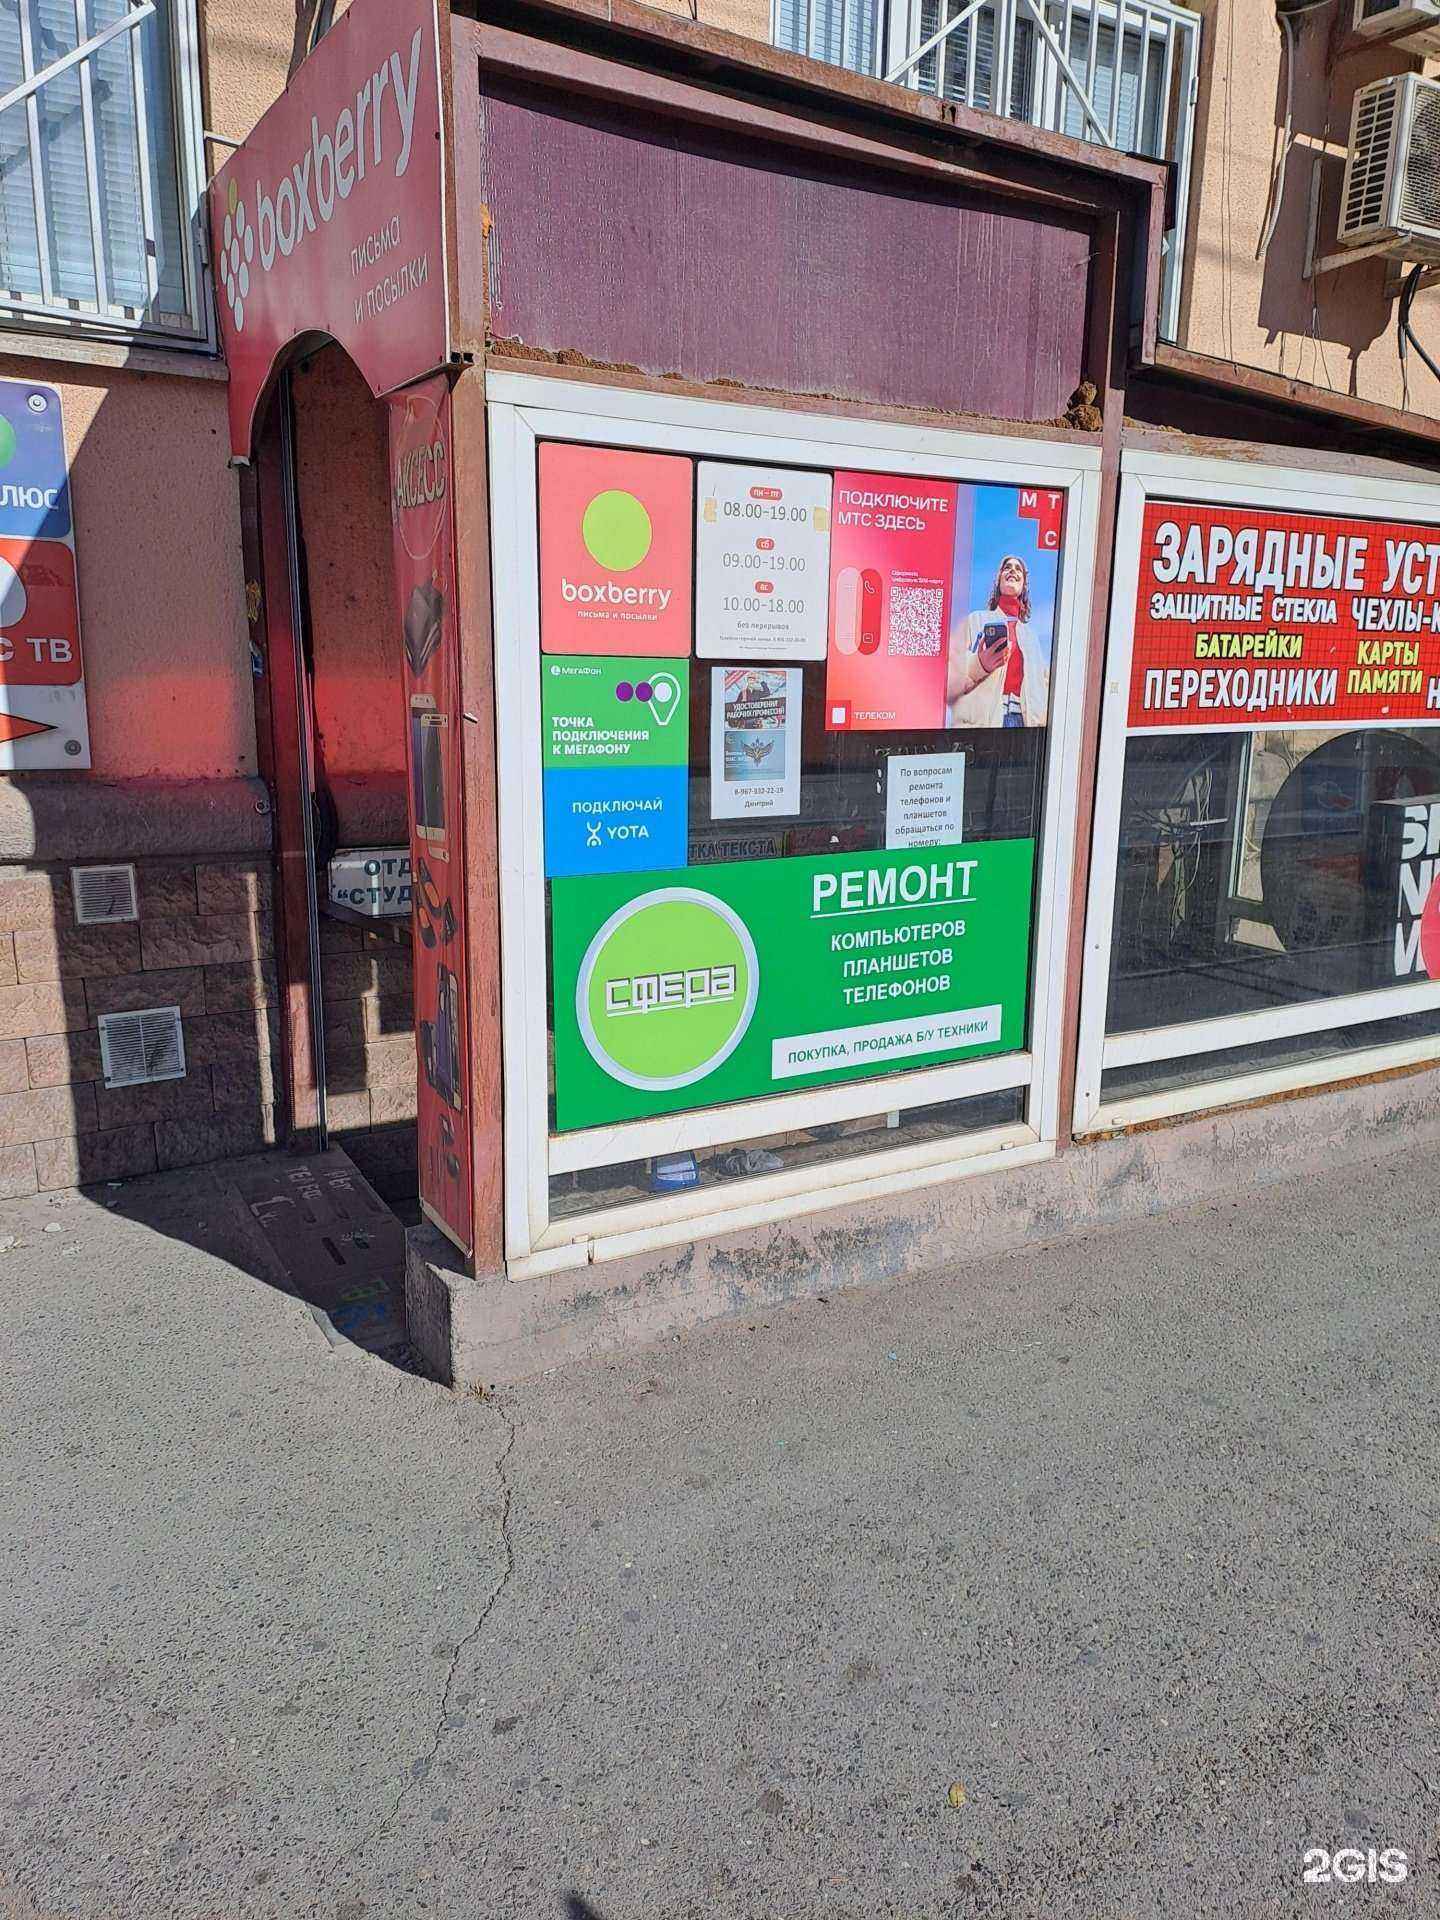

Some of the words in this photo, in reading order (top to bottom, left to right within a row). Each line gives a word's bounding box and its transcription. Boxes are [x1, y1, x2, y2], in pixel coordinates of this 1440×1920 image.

[257, 27, 422, 272] boxberry
[351, 215, 401, 276] письма
[354, 302, 364, 325] и
[367, 253, 429, 317] посылки
[723, 501, 807, 522] 08.00-19.00
[839, 490, 949, 513] ПОДКЛЮЧИТЕ
[838, 512, 872, 528] МТС
[875, 514, 926, 531] ЗДЕСЬ
[722, 552, 806, 572] 09.00-19.00
[1152, 520, 1369, 595] ЗАРЯДНЫЕ
[1382, 539, 1440, 595] УСТ
[561, 576, 672, 611] boxberry
[723, 596, 805, 613] 10.00-18.00
[1150, 591, 1263, 624] ЗАЩИТНЫЕ
[1271, 596, 1338, 624] СТЕКЛА
[577, 609, 610, 620] письма
[612, 612, 618, 620] и
[620, 611, 658, 621] посылки
[737, 620, 749, 630] без
[26, 637, 73, 664] ТВ
[1195, 629, 1303, 659] БАТАРЕЙКИ
[1356, 640, 1420, 666] КАРТЫ
[1143, 668, 1339, 712] ПЕРЕХОДНИКИ
[1346, 668, 1423, 694] ПАМЯТИ
[552, 716, 594, 729] ТОЧКА
[854, 711, 896, 721] ТЕЛЕКОМ
[552, 730, 650, 743] ПОДКЛЮЧЕНИЯ
[552, 745, 561, 756] К
[564, 743, 631, 755] МЕГАФОНУ
[900, 768, 911, 777] По
[913, 767, 953, 778] вопросам
[908, 782, 943, 793] ремонта
[572, 796, 663, 814] ПОДКЛЮЧАЙ
[744, 799, 774, 808] Дмитрий
[900, 795, 944, 807] телефонов
[946, 795, 951, 803] и
[903, 809, 947, 820] планшетов
[607, 825, 649, 841] YOTA
[895, 824, 943, 837] обращаться
[945, 823, 955, 831] по
[812, 860, 978, 913] РЕМОНТ
[831, 919, 966, 952] КОМПЬЮТЕРОВ
[843, 948, 953, 978] ПЛАНШЕТОВ
[843, 974, 951, 1006] ТЕЛЕФОНОВ
[788, 1042, 851, 1065] ПОКУПКА,
[853, 1033, 913, 1054] ПРОДАЖА
[916, 1029, 935, 1044] Б/У
[936, 1020, 989, 1040] ТЕХНИКИ
